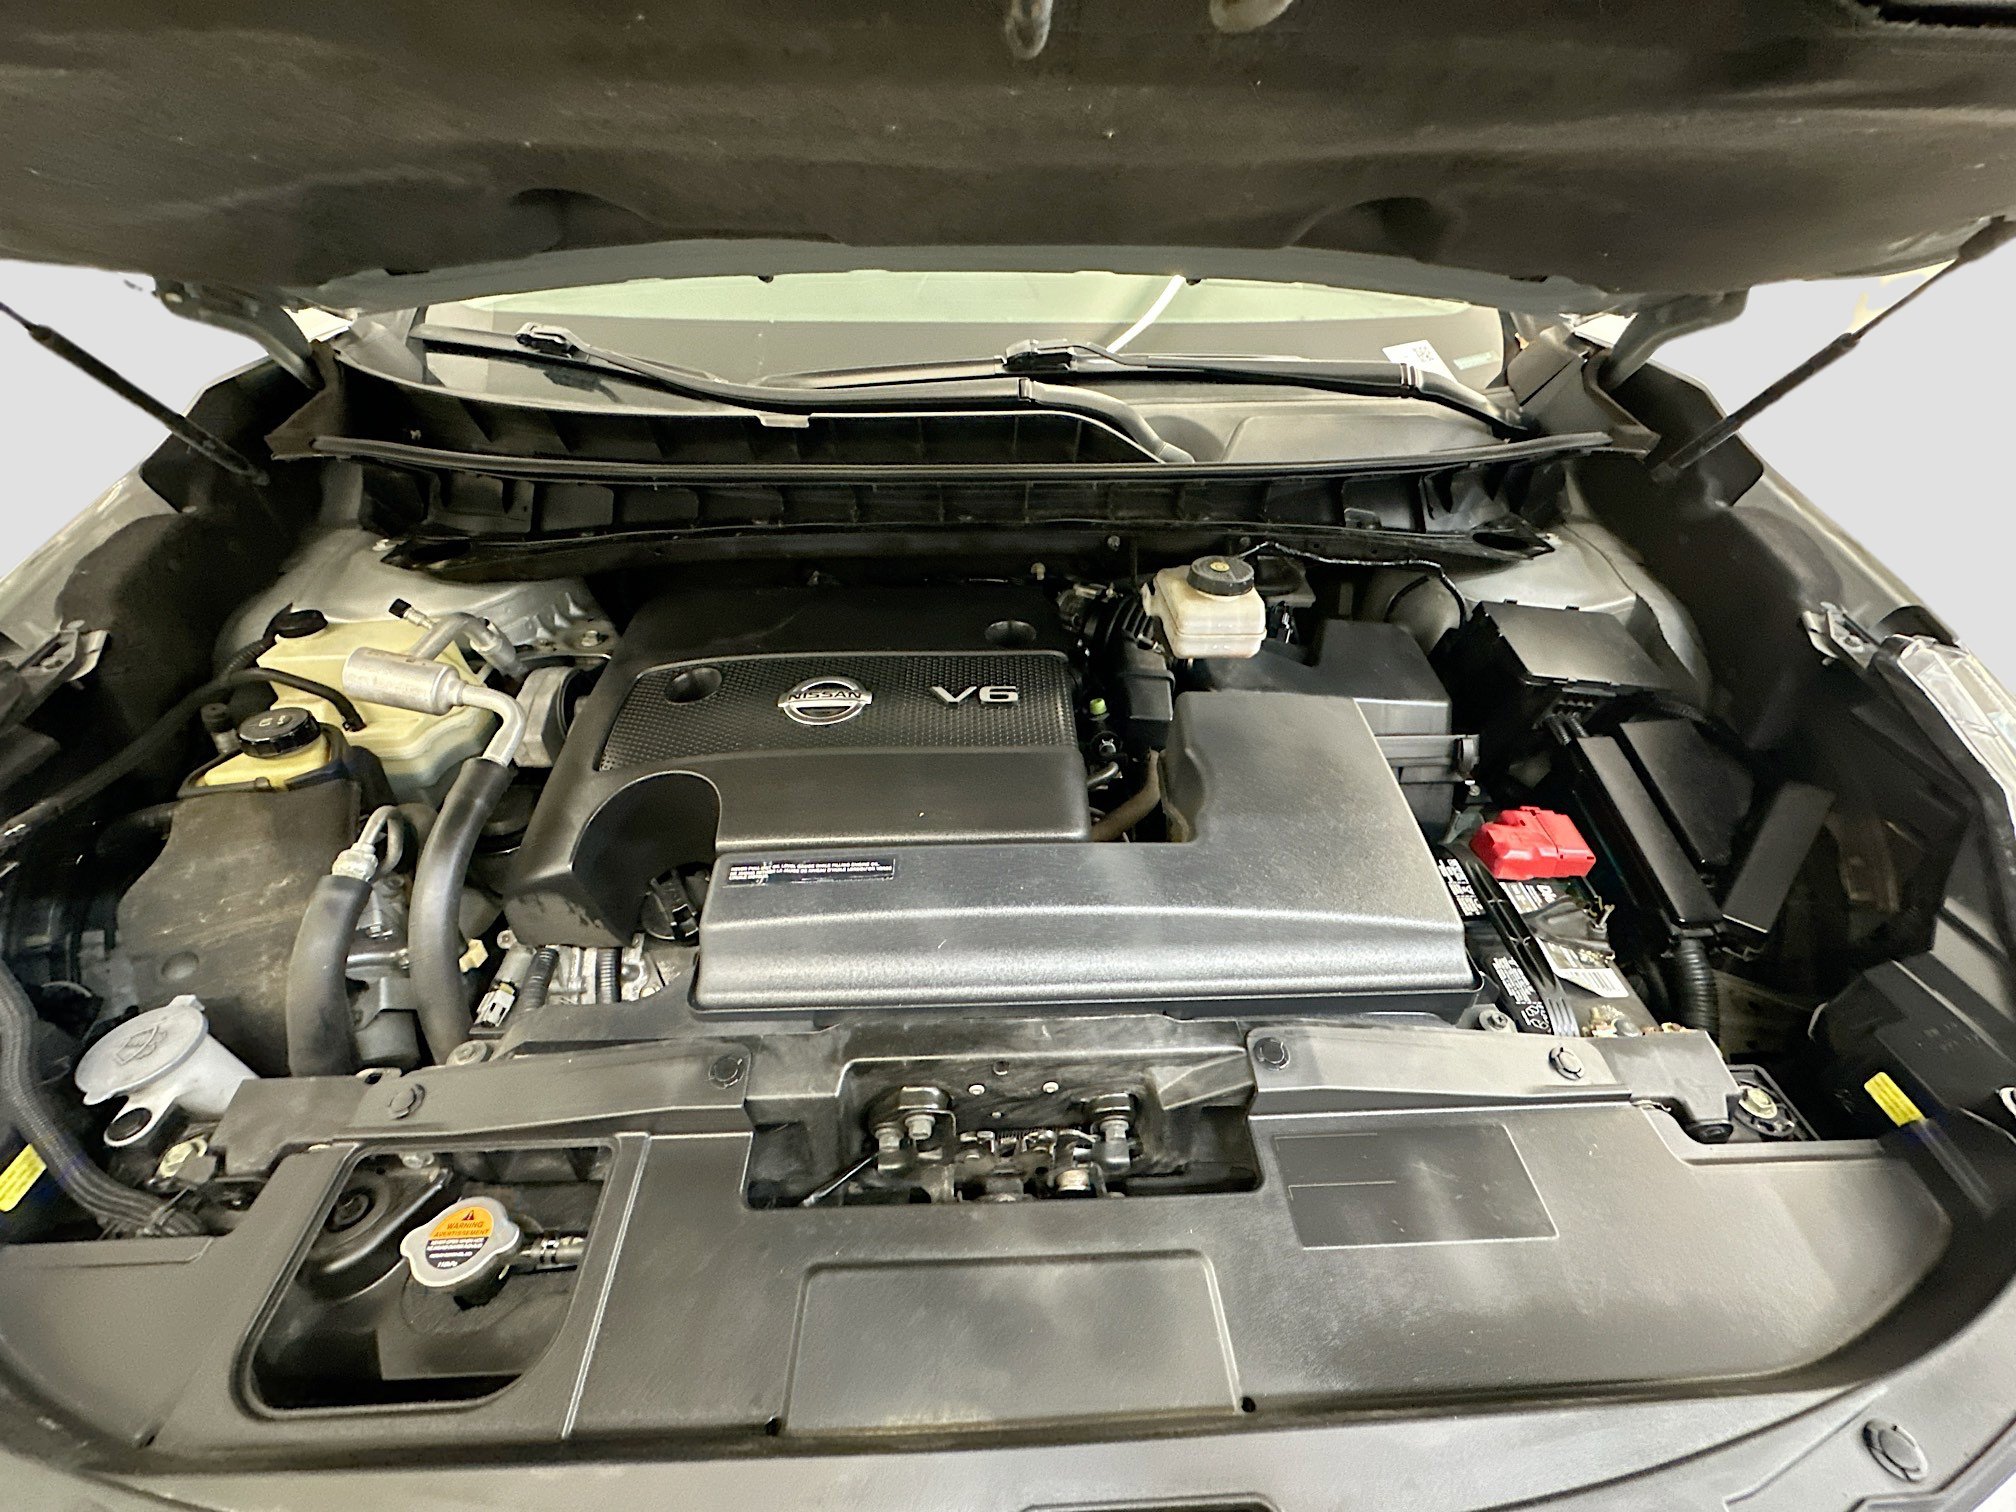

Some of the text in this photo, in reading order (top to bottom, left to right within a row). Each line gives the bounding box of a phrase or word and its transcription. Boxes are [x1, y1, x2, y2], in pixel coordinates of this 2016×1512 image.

[788, 690, 861, 701] NISSAN
[931, 686, 1019, 702] V6
[446, 1221, 485, 1230] WARNING
[434, 1229, 490, 1237] AVERTISSEMENT
